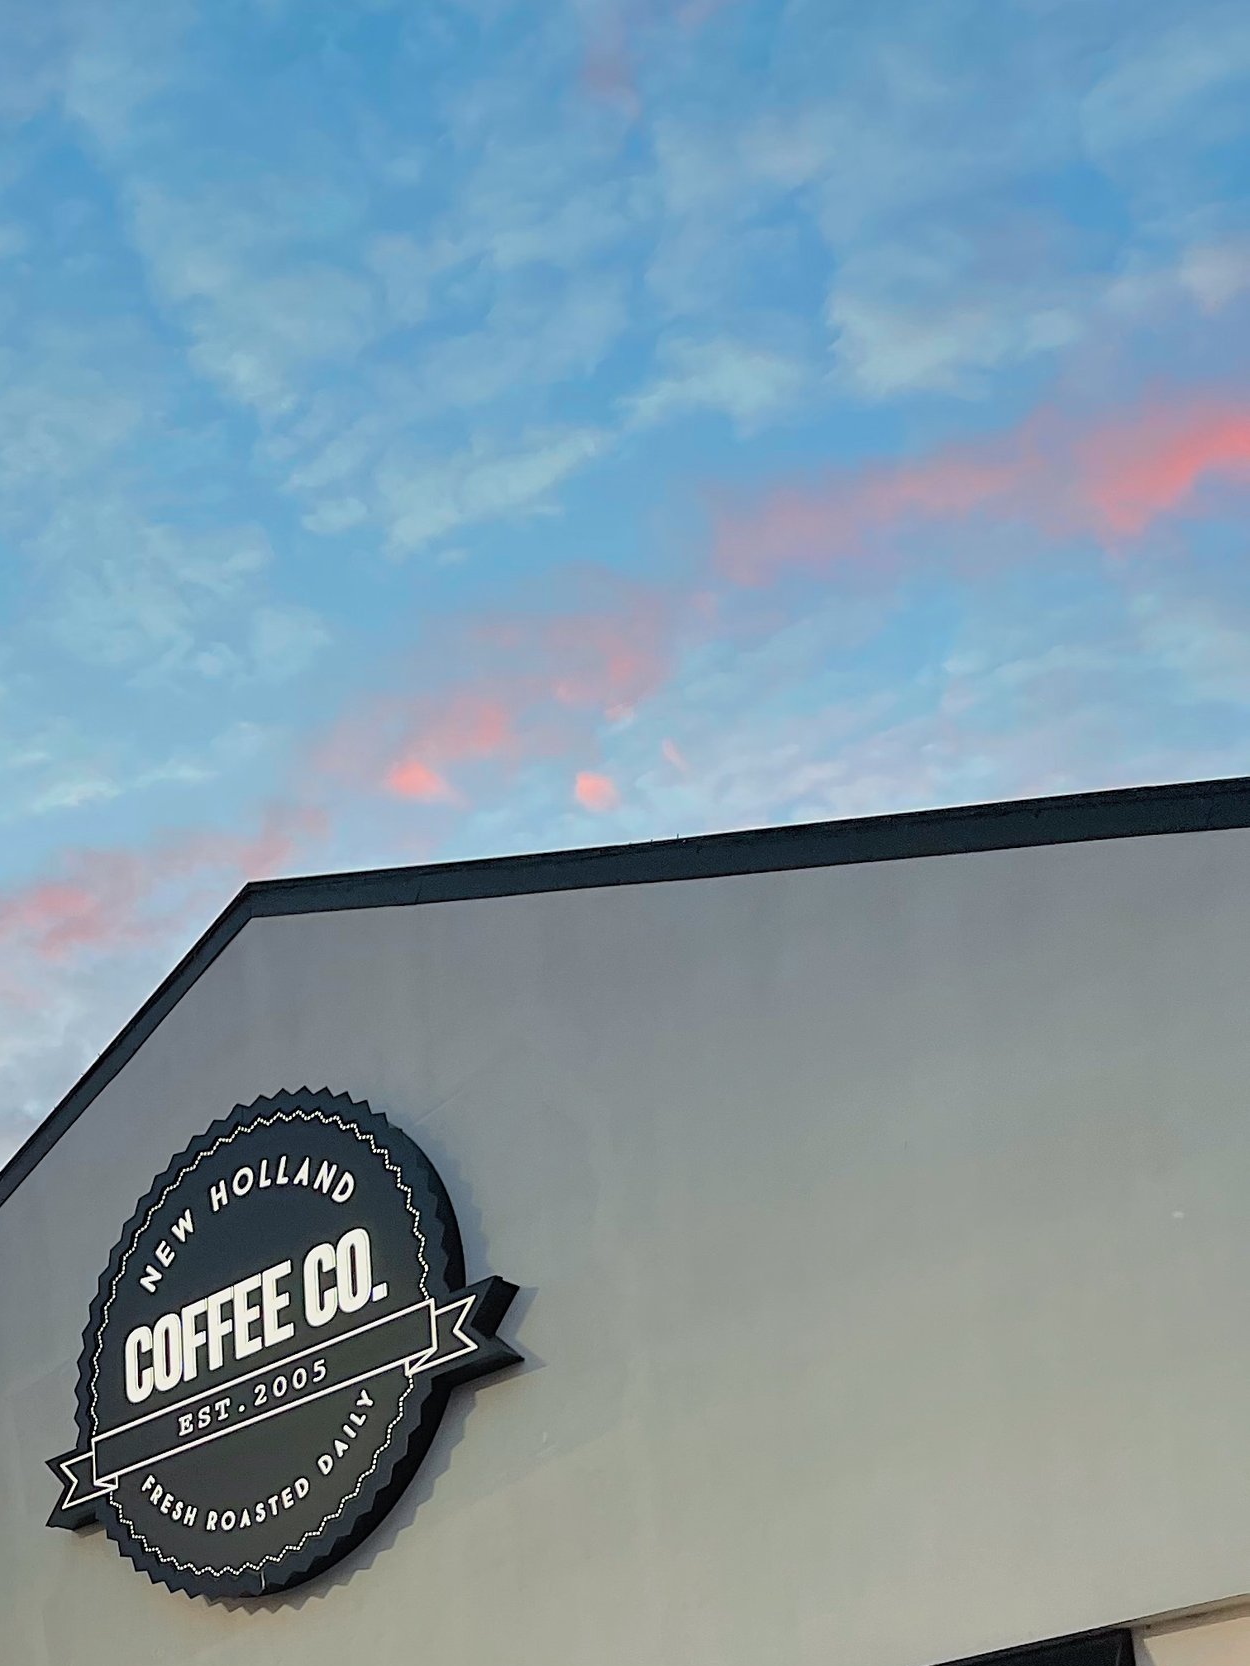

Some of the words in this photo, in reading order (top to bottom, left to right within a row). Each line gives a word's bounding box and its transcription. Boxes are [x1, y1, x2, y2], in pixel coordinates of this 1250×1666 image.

[140, 1209, 195, 1293] NEW
[209, 1155, 356, 1213] HOLLAND
[124, 1258, 296, 1404] COFFEE
[302, 1227, 389, 1328] CO.
[141, 1474, 198, 1528] FRESH
[205, 1478, 310, 1532] ROASTED
[317, 1389, 375, 1476] DAILY
